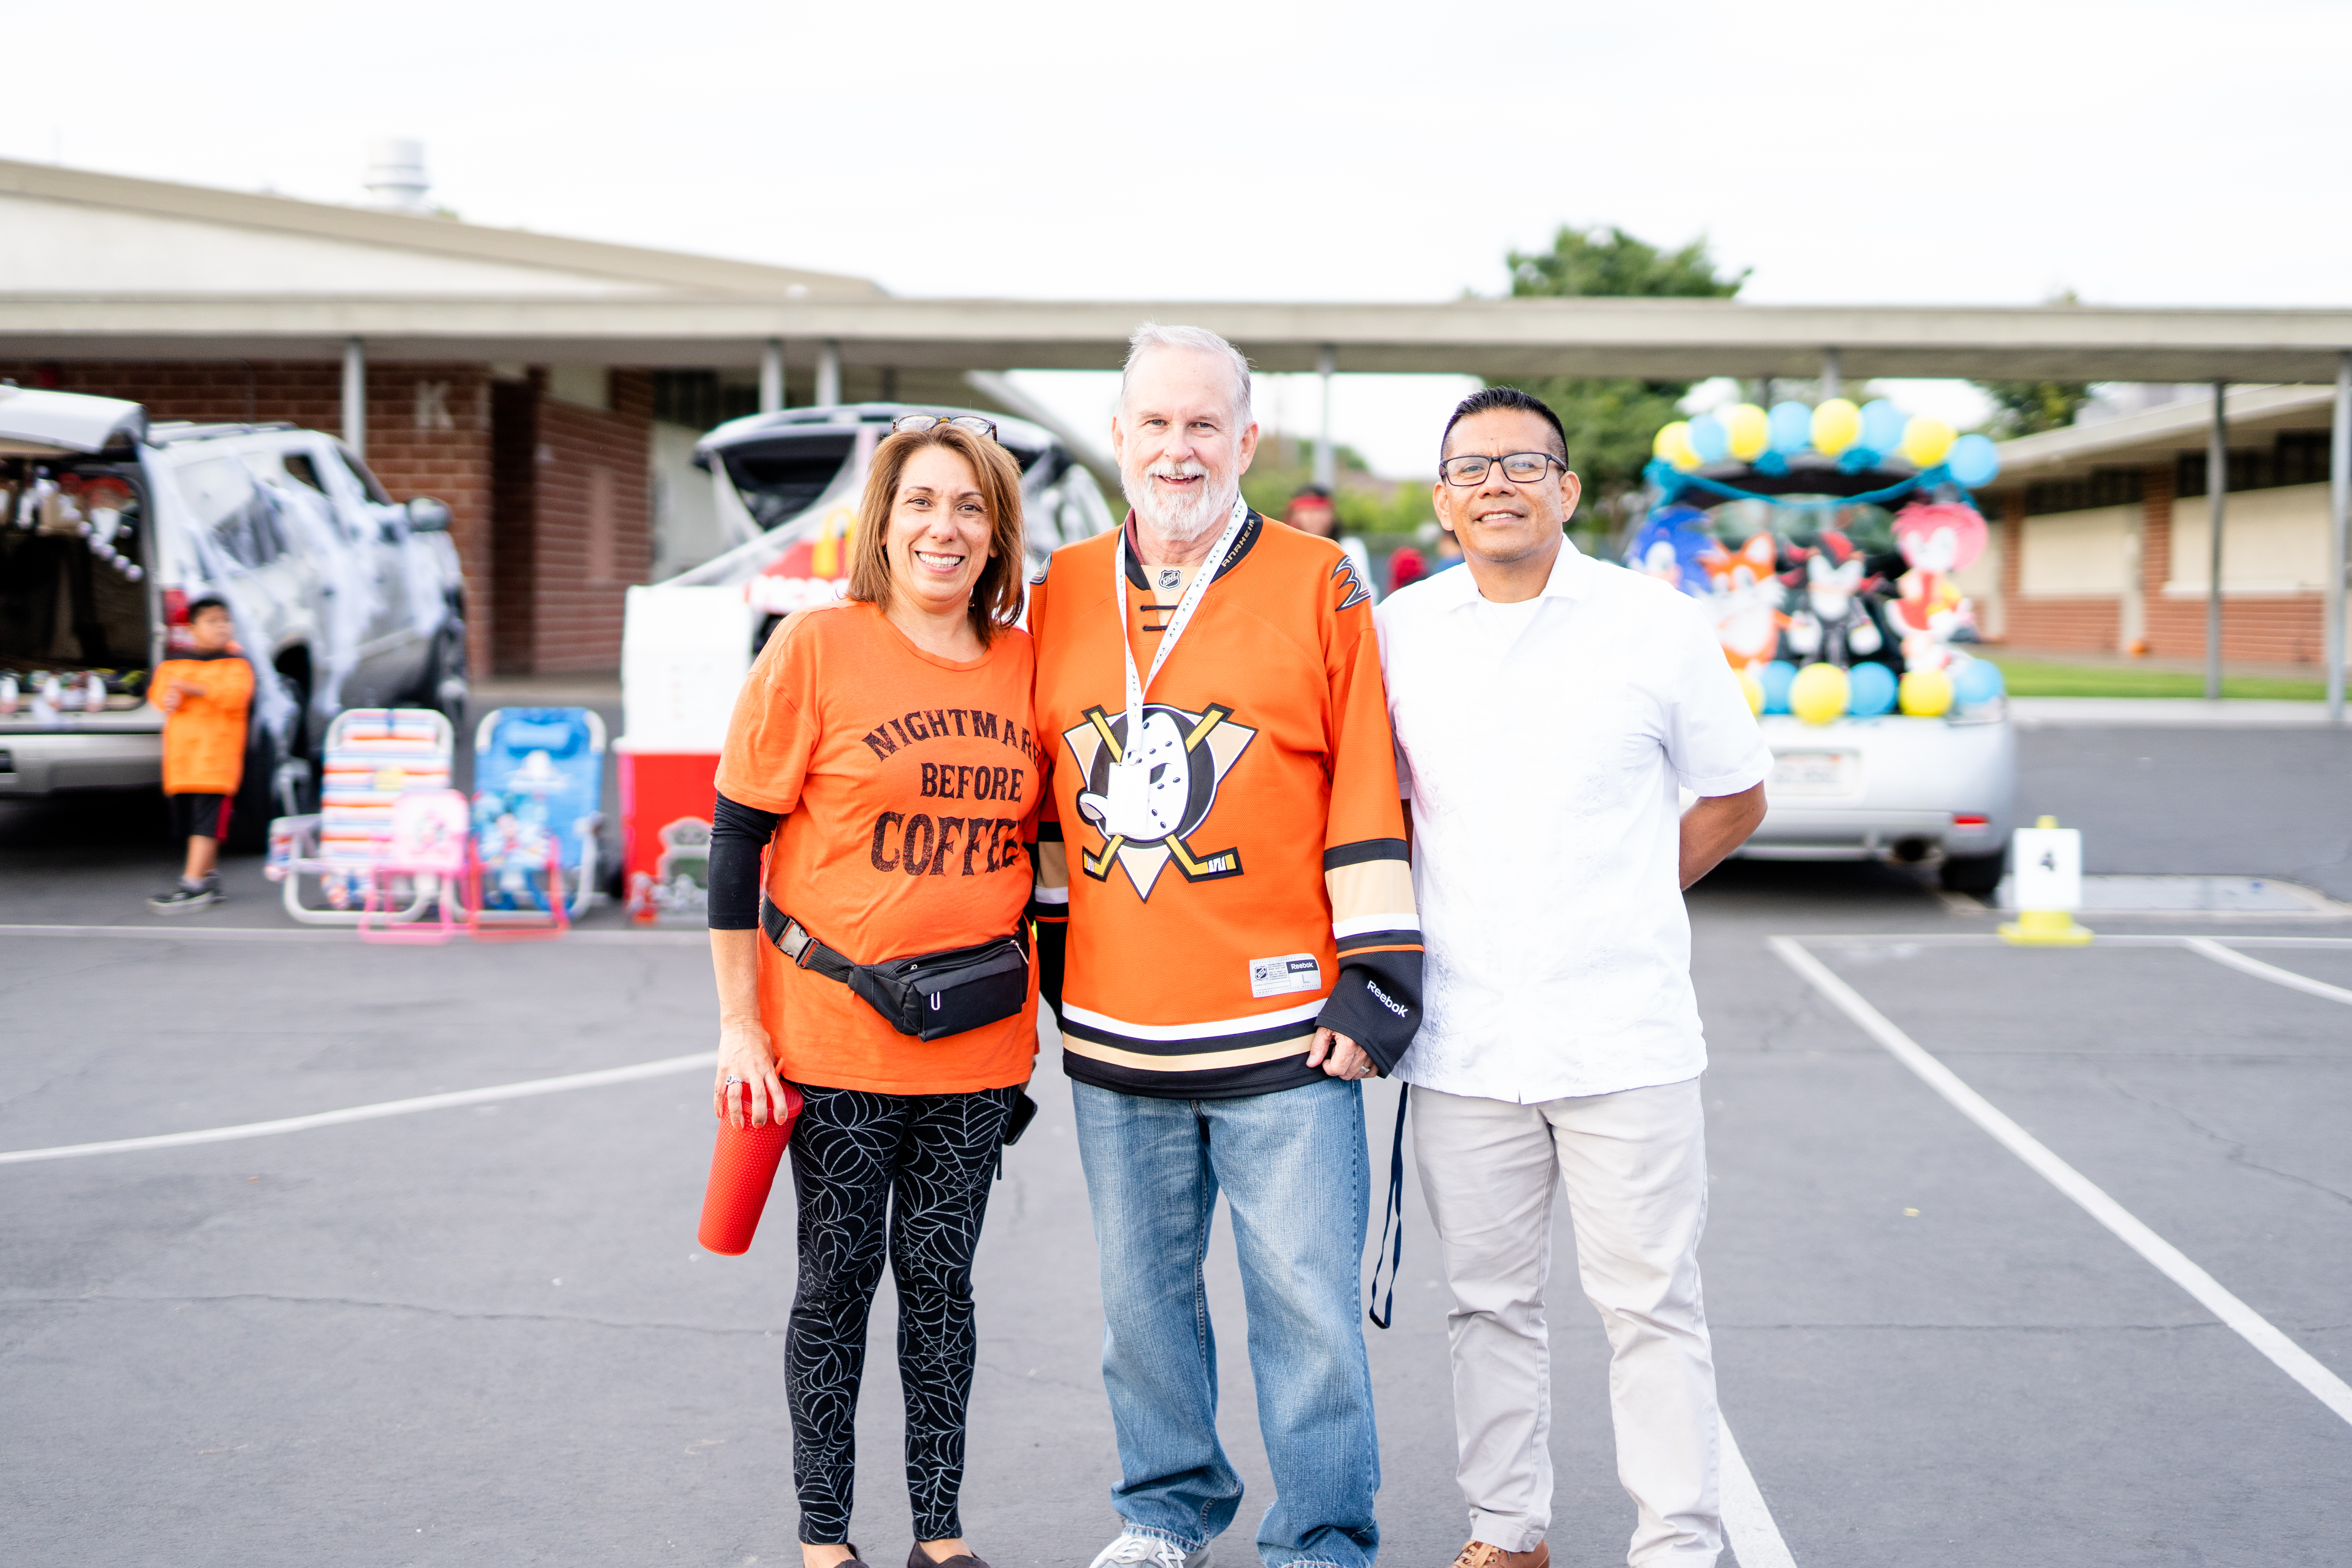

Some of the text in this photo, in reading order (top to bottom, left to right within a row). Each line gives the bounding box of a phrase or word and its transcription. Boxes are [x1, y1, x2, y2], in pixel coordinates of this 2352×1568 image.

[1221, 519, 1254, 567] ANAHEIM
[1163, 573, 1177, 585] NHL
[920, 762, 1024, 803] BEFORE
[2041, 852, 2055, 872] 4
[1258, 969, 1266, 978] NHL
[1302, 974, 1310, 984] L
[1367, 980, 1408, 1017] Reebok
